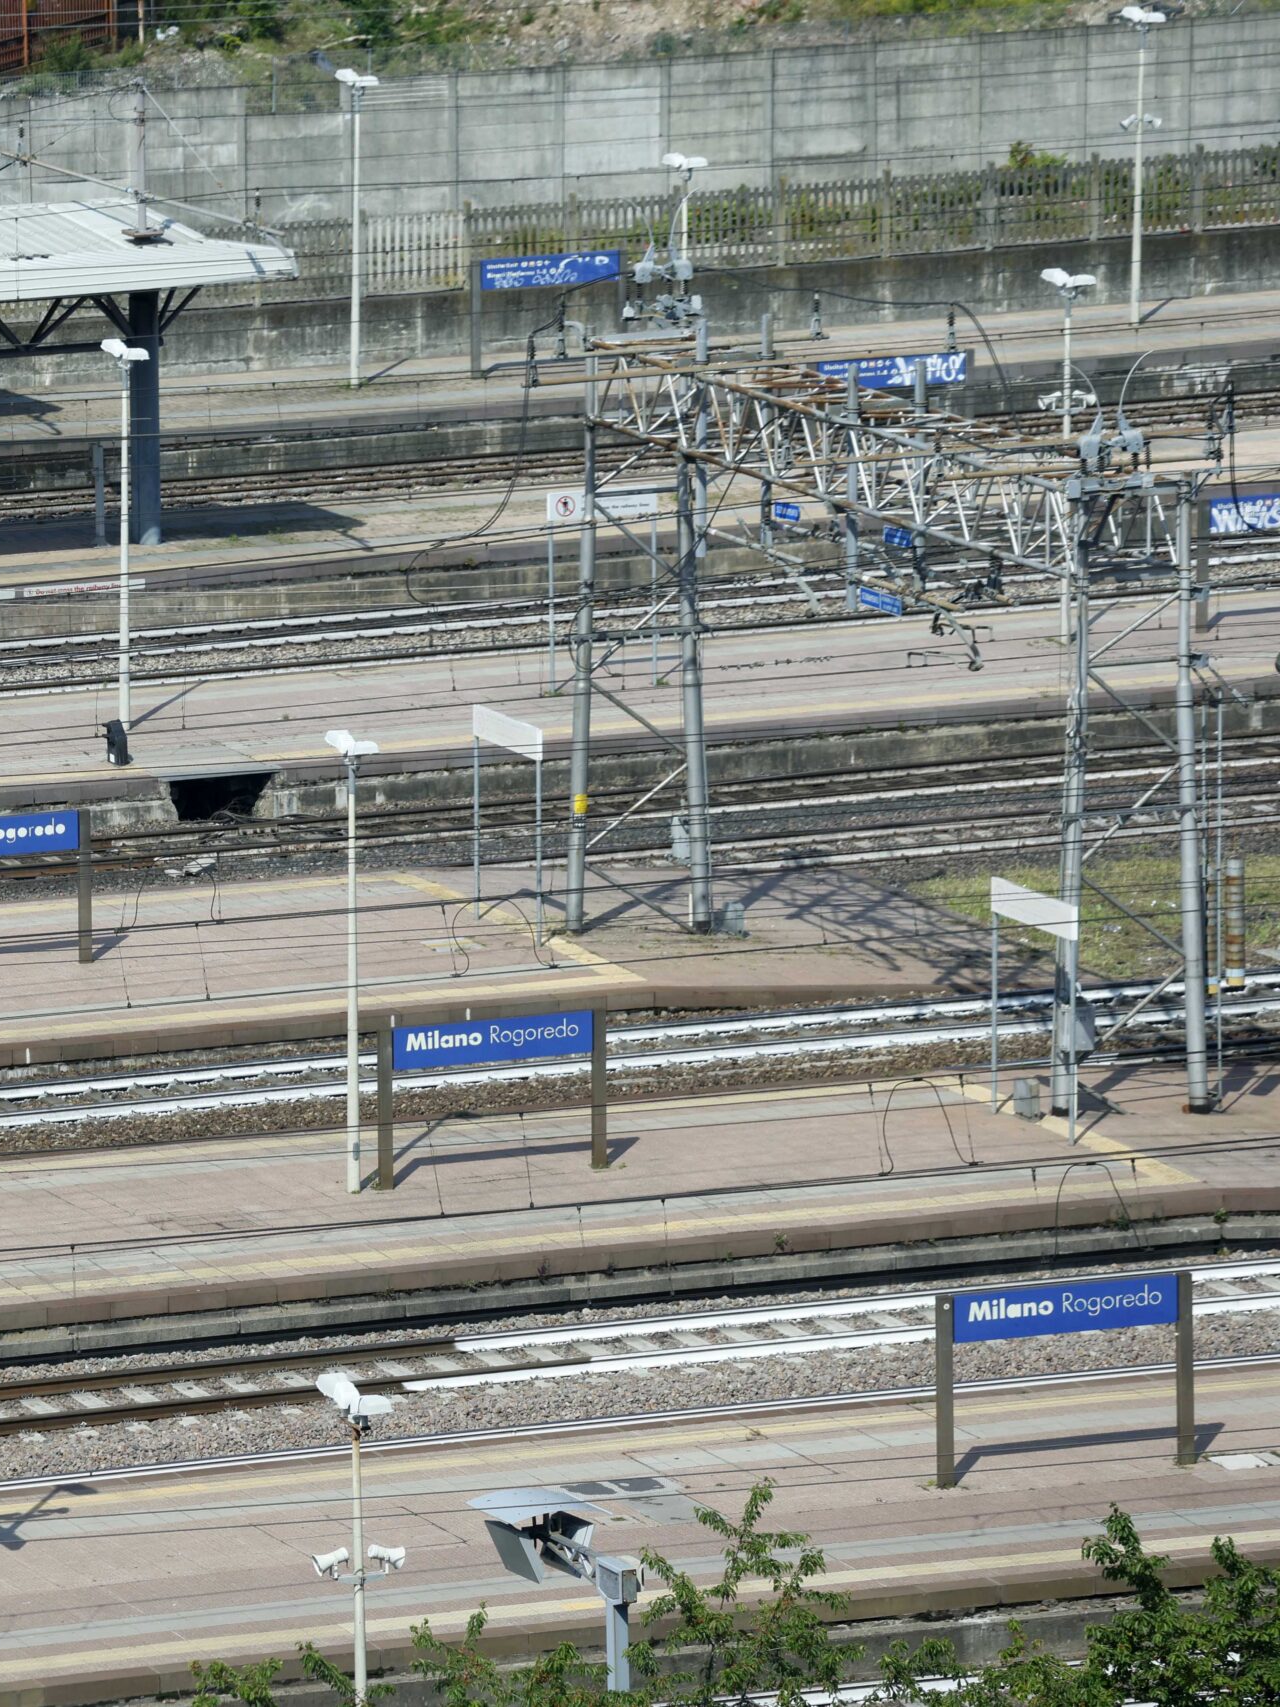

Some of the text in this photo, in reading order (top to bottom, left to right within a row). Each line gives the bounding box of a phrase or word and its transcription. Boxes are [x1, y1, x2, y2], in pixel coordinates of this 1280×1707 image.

[405, 1018, 580, 1052] Milano Rogoredo
[967, 1283, 1163, 1322] Milano Rogoredo
